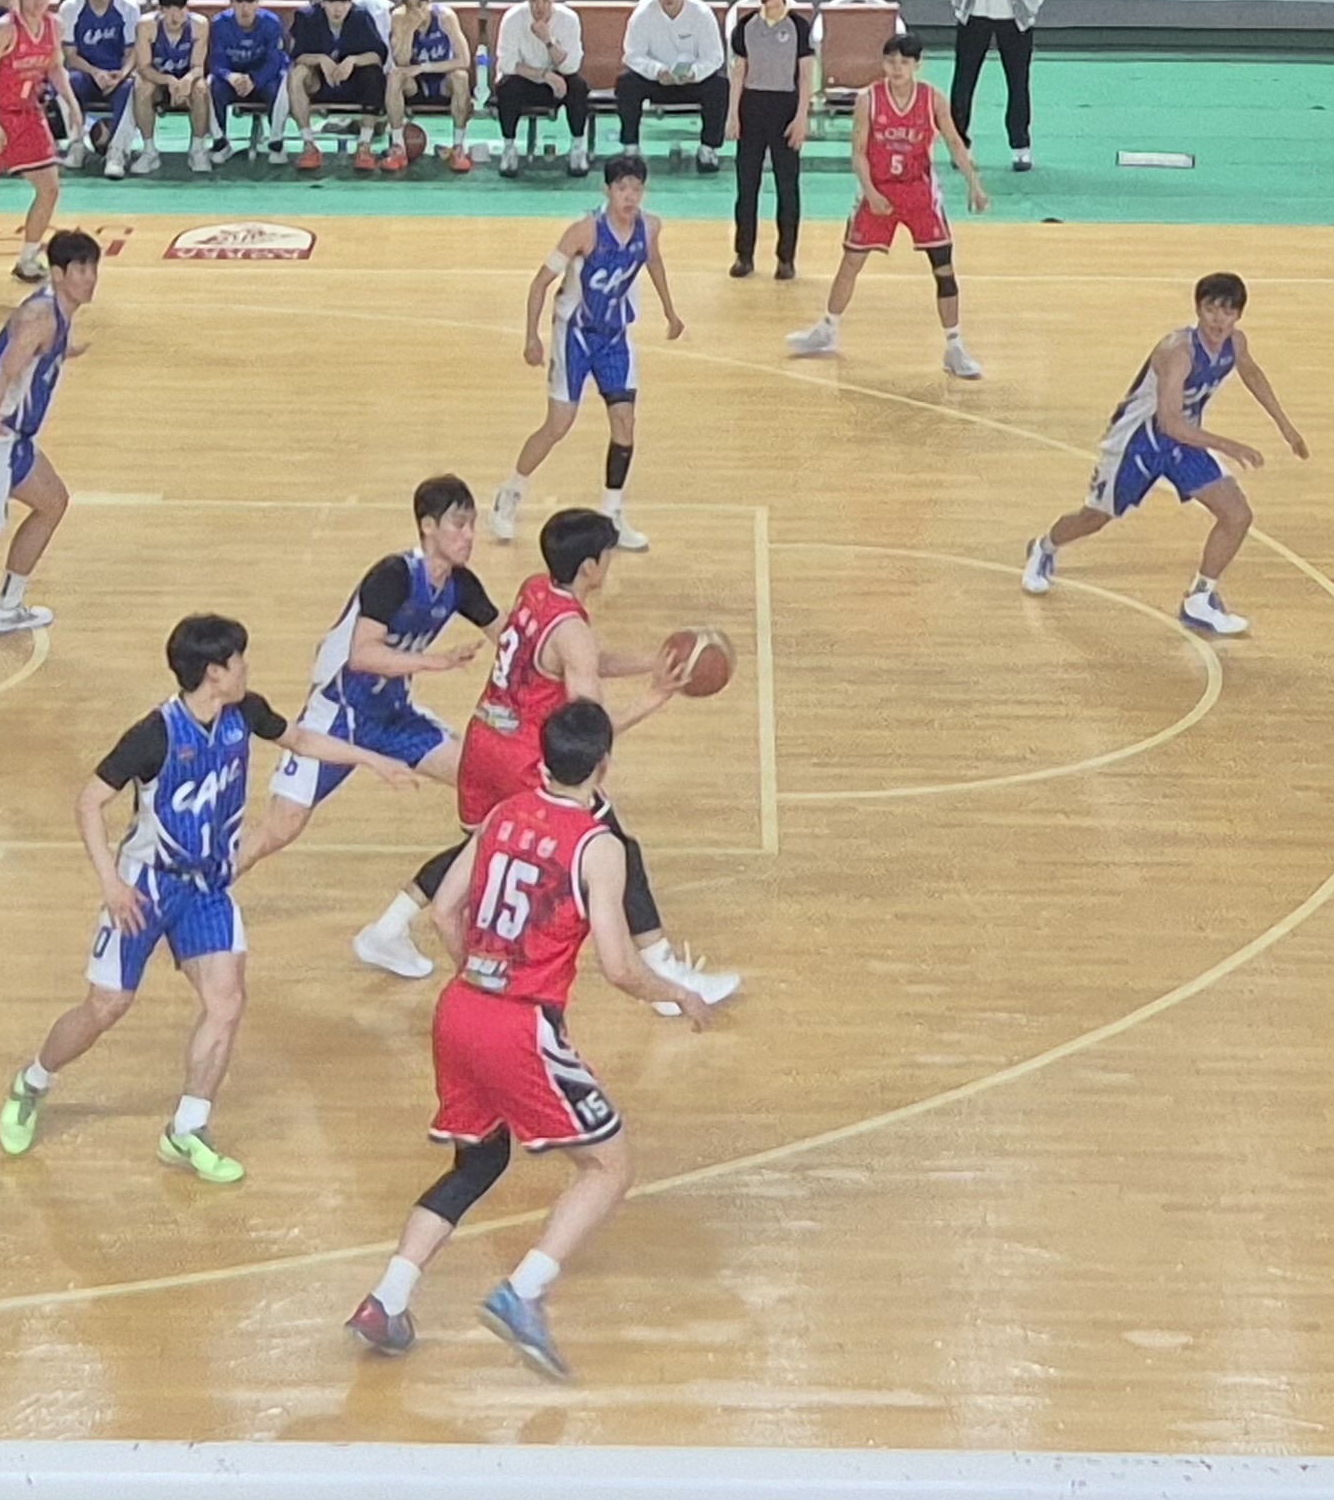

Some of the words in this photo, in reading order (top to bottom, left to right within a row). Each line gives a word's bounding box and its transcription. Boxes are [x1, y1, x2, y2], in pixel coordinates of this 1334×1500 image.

[889, 153, 905, 177] 5
[476, 851, 540, 943] 15
[576, 1089, 609, 1126] 15
